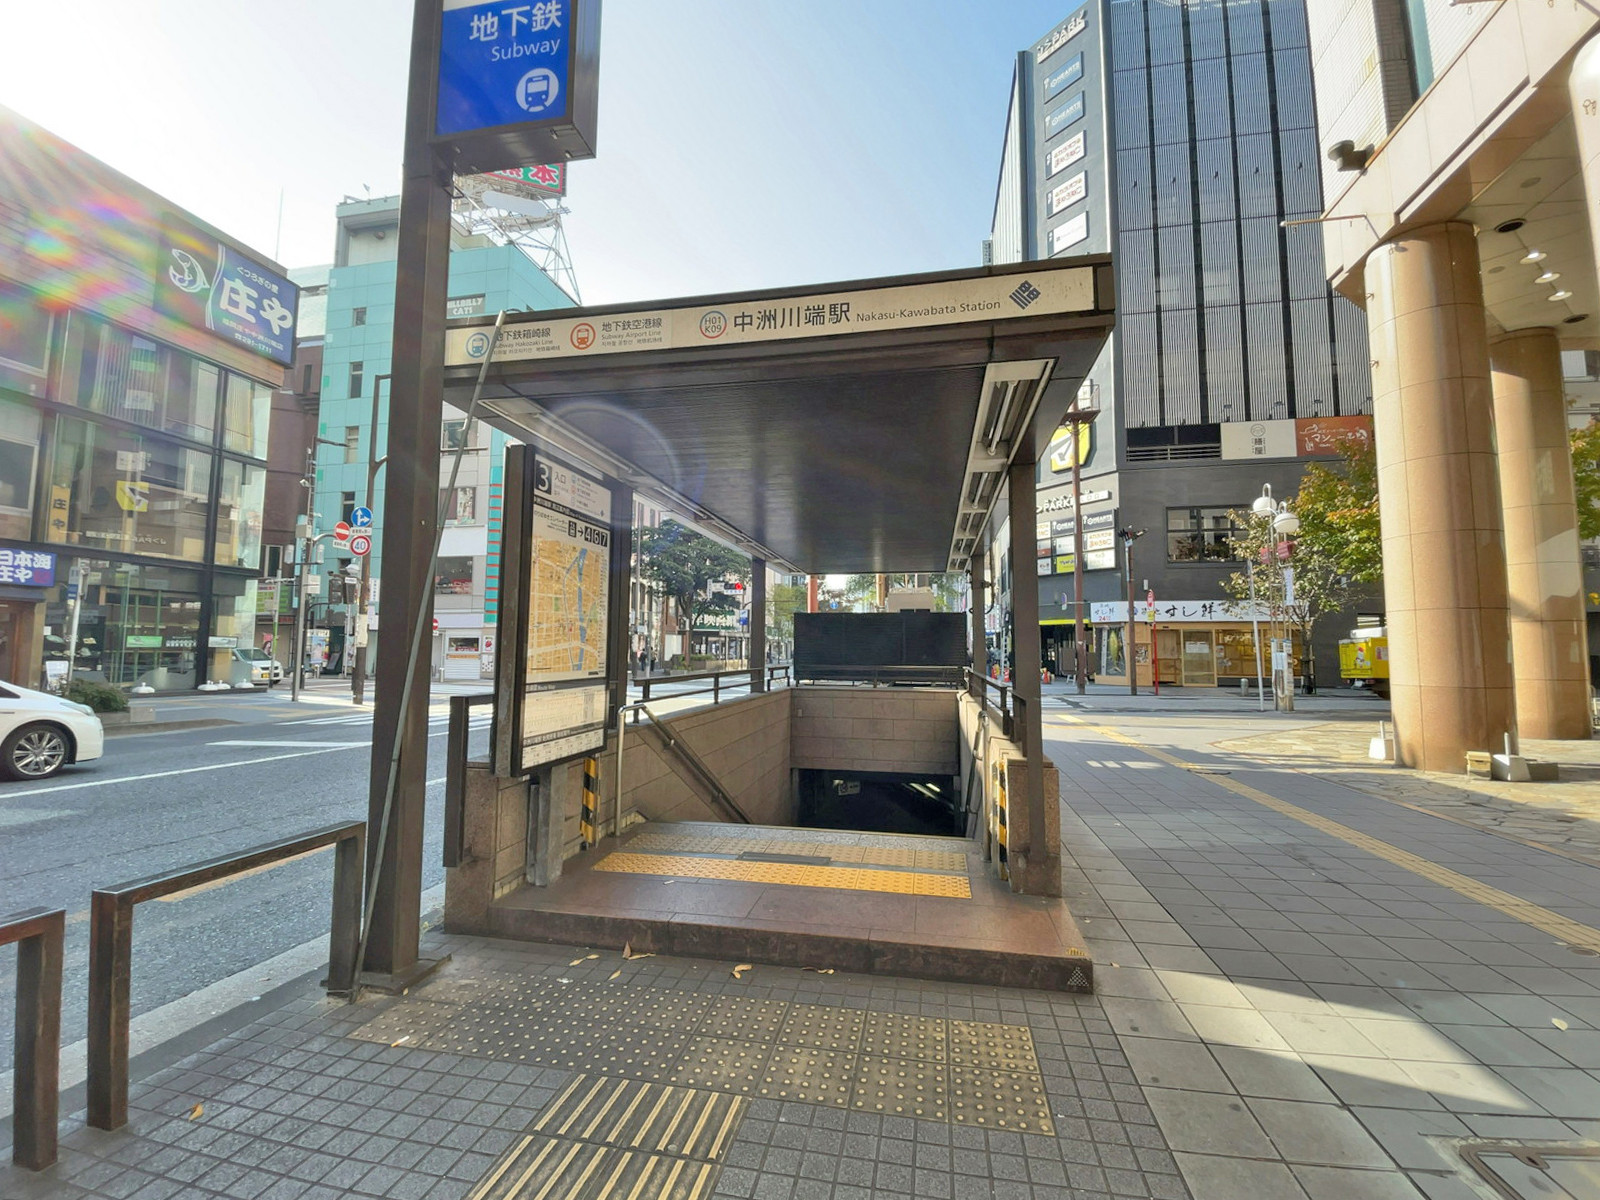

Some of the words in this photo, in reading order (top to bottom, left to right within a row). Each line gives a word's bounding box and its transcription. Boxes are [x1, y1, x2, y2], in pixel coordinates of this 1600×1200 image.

[468, 0, 562, 42] 地下鉄
[491, 39, 561, 62] Subway
[219, 277, 293, 336] 庄や
[856, 304, 956, 323] Nakasu-Kawabata
[959, 300, 1001, 313] Station
[601, 317, 663, 333] 地下鉄空港線
[704, 315, 722, 325] H01
[733, 302, 850, 333] 中洲川端駅
[601, 333, 625, 341] Subway
[625, 331, 648, 339] Airport
[704, 324, 722, 334] K09
[538, 464, 549, 491] 3
[554, 471, 567, 485] 入口
[355, 541, 366, 551] 40
